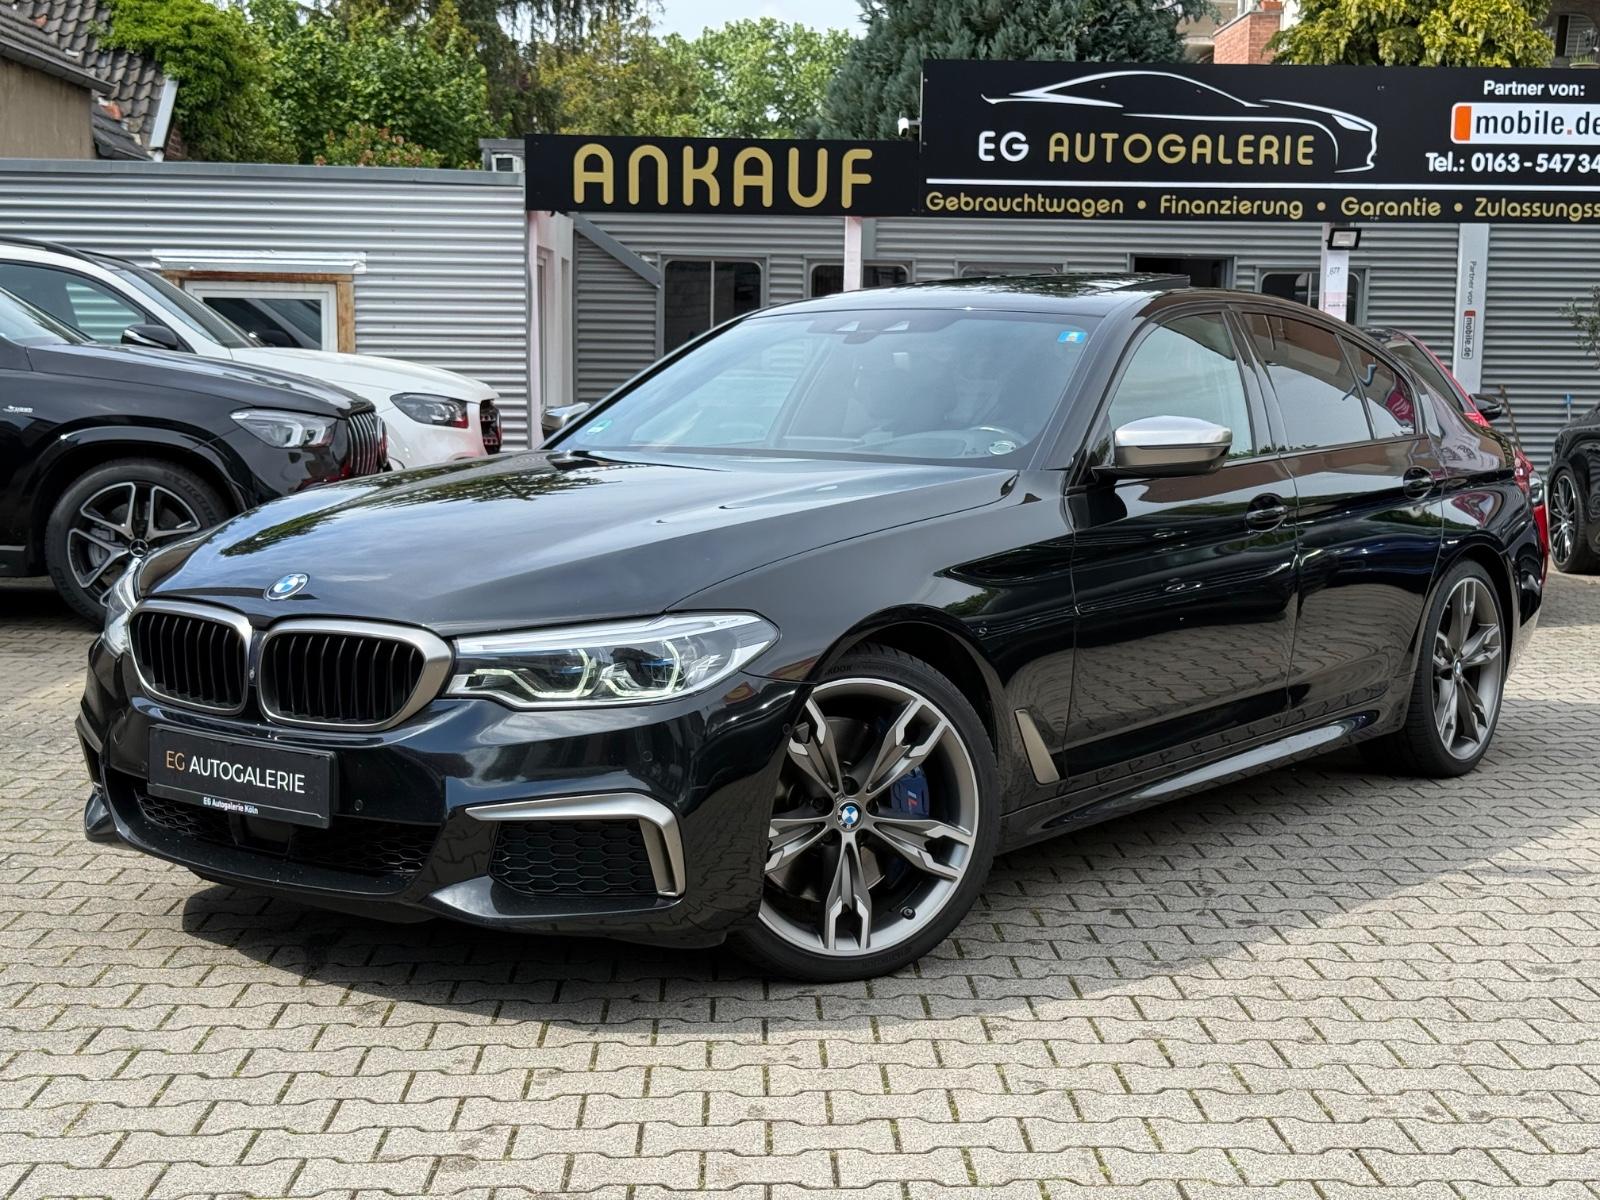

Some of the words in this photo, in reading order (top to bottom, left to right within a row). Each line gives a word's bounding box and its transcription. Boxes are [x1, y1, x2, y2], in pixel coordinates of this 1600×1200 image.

[1483, 80, 1545, 97] Partner
[1548, 82, 1586, 97] von:
[1475, 109, 1600, 136] mobile.de
[978, 130, 1030, 163] EG
[1048, 131, 1315, 167] AUTOGALERIE
[1425, 151, 1465, 173] Tel.:
[572, 143, 873, 209] ANKAUF
[925, 191, 1124, 218] Gebrauchtwagen
[1159, 195, 1304, 220] Finanzierung
[1340, 196, 1442, 218] Garantie
[1474, 197, 1600, 223] Zulassungss
[1463, 317, 1473, 357] mobile.de
[165, 750, 186, 771] EG
[188, 755, 306, 794] AUTOGALERIE
[203, 796, 212, 806] EG
[211, 798, 244, 812] Autogalerie
[244, 803, 259, 815] Köln
